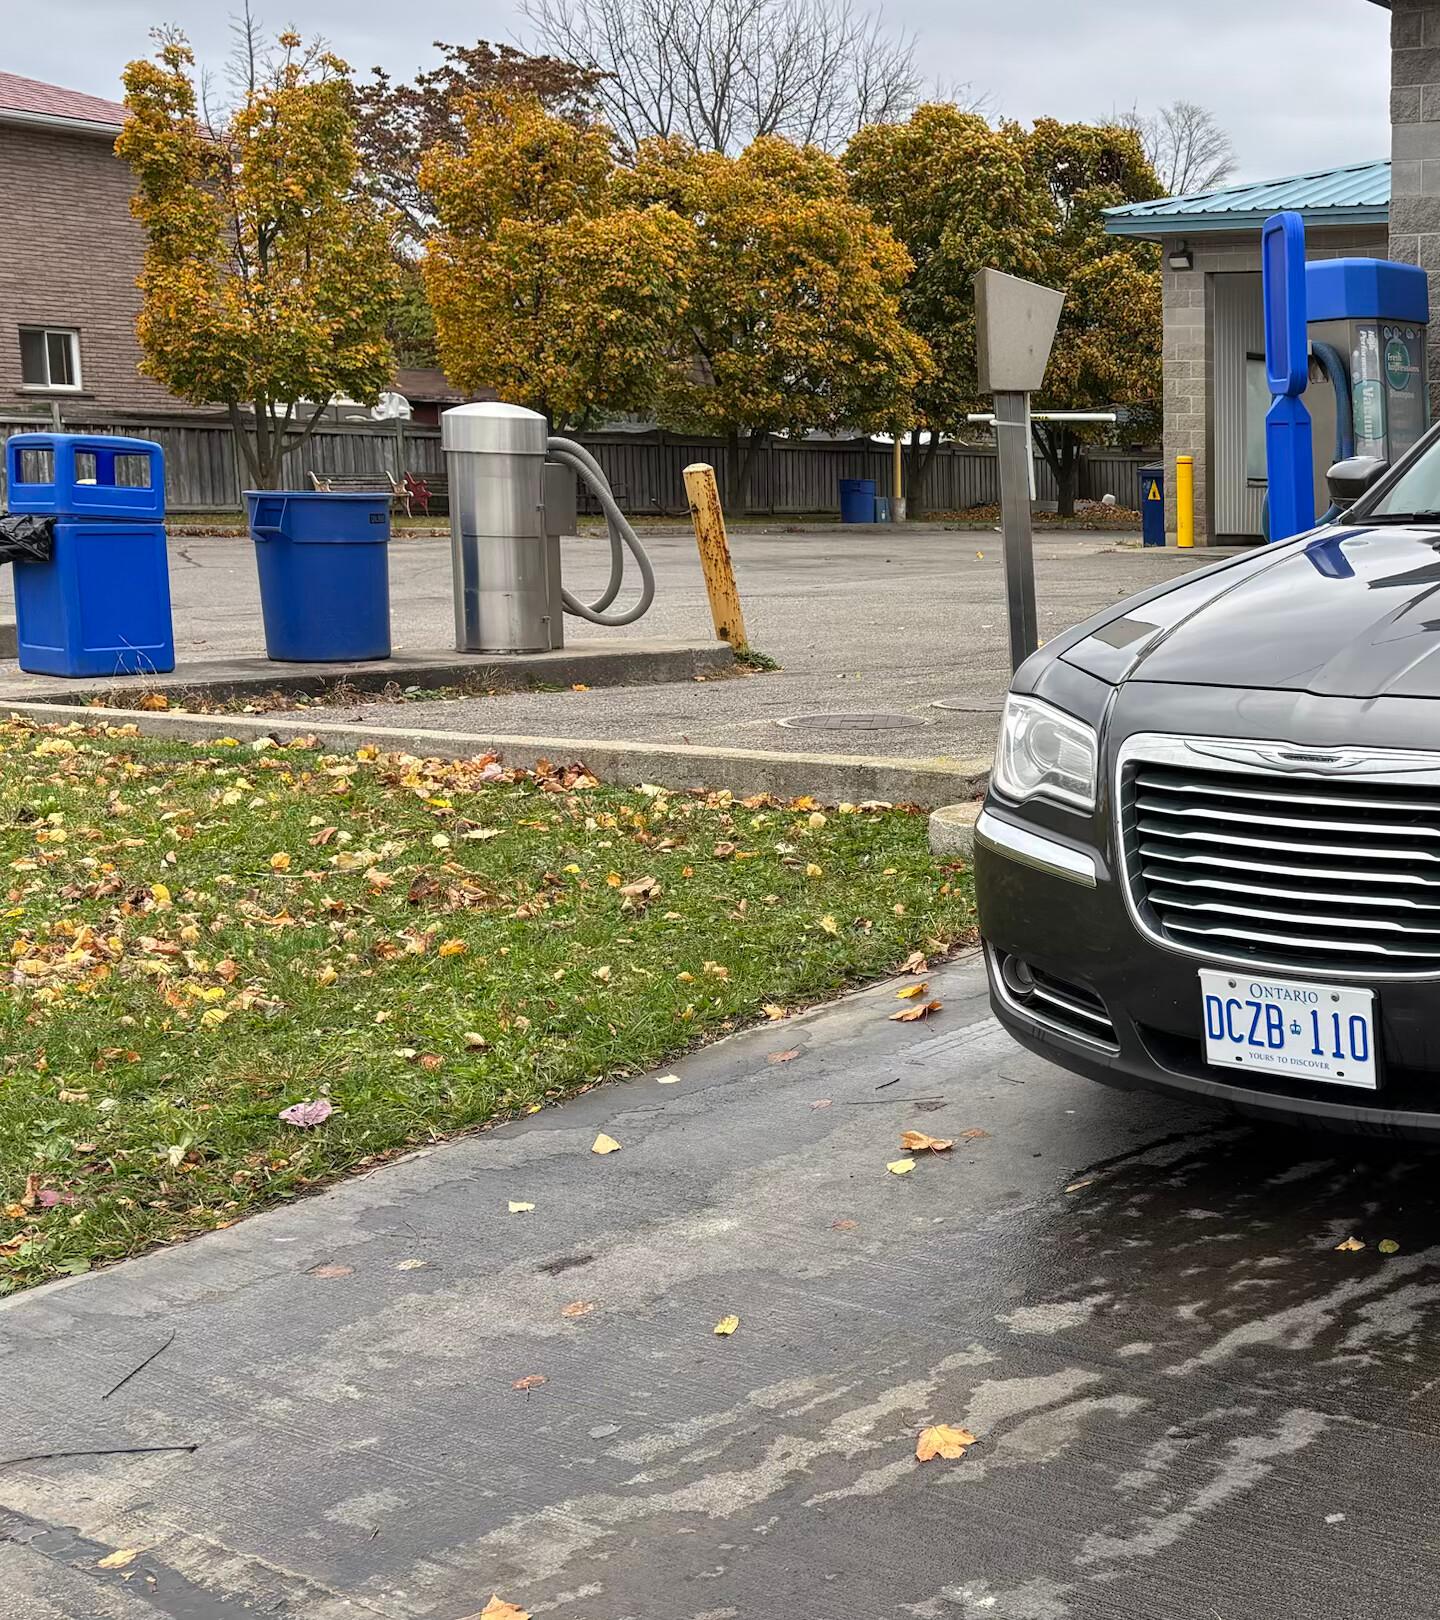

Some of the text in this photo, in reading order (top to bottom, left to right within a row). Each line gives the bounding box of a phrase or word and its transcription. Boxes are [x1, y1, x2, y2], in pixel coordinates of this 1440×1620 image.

[1362, 387, 1374, 446] Vacuum
[1206, 995, 1369, 1062] DCZB 110
[1249, 1051, 1330, 1070] YOURS TO DISCOVER
